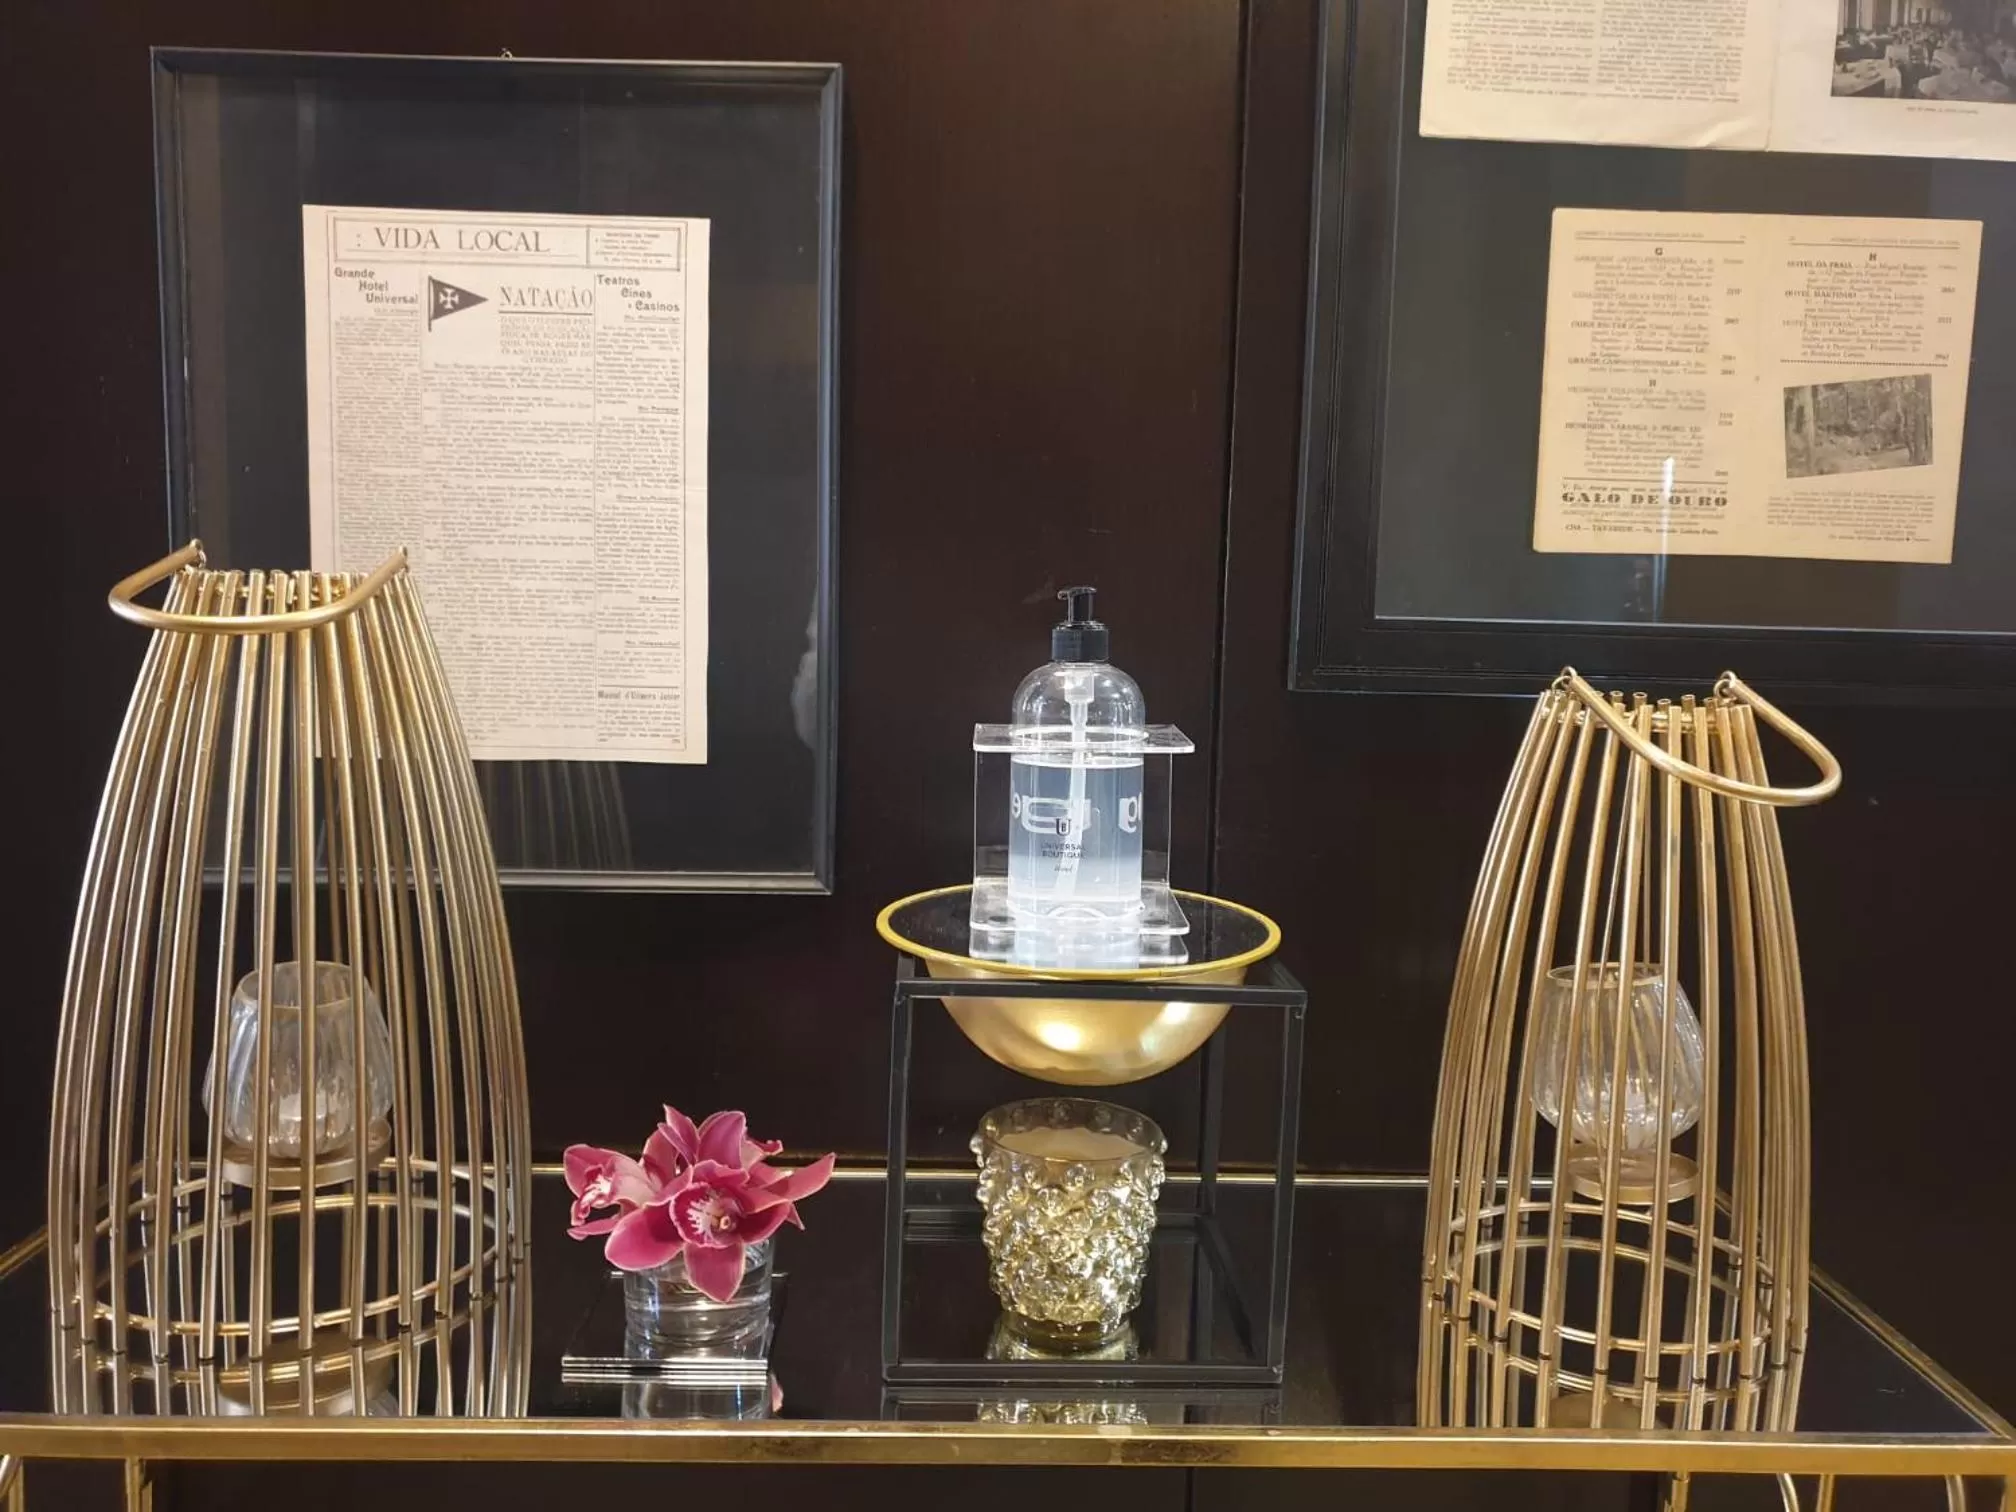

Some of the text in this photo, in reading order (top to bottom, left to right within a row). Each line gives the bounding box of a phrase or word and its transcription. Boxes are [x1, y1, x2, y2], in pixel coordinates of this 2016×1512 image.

[374, 227, 551, 253] VIDA LOCAL
[334, 266, 375, 279] Grande
[359, 280, 389, 292] Hotel
[597, 274, 640, 285] Teatros
[366, 292, 418, 305] Universal
[500, 286, 593, 309] NATAÇÃO
[621, 287, 652, 299] Cines
[635, 300, 680, 313] Casinos
[1562, 492, 1728, 507] GALO DE OURO
